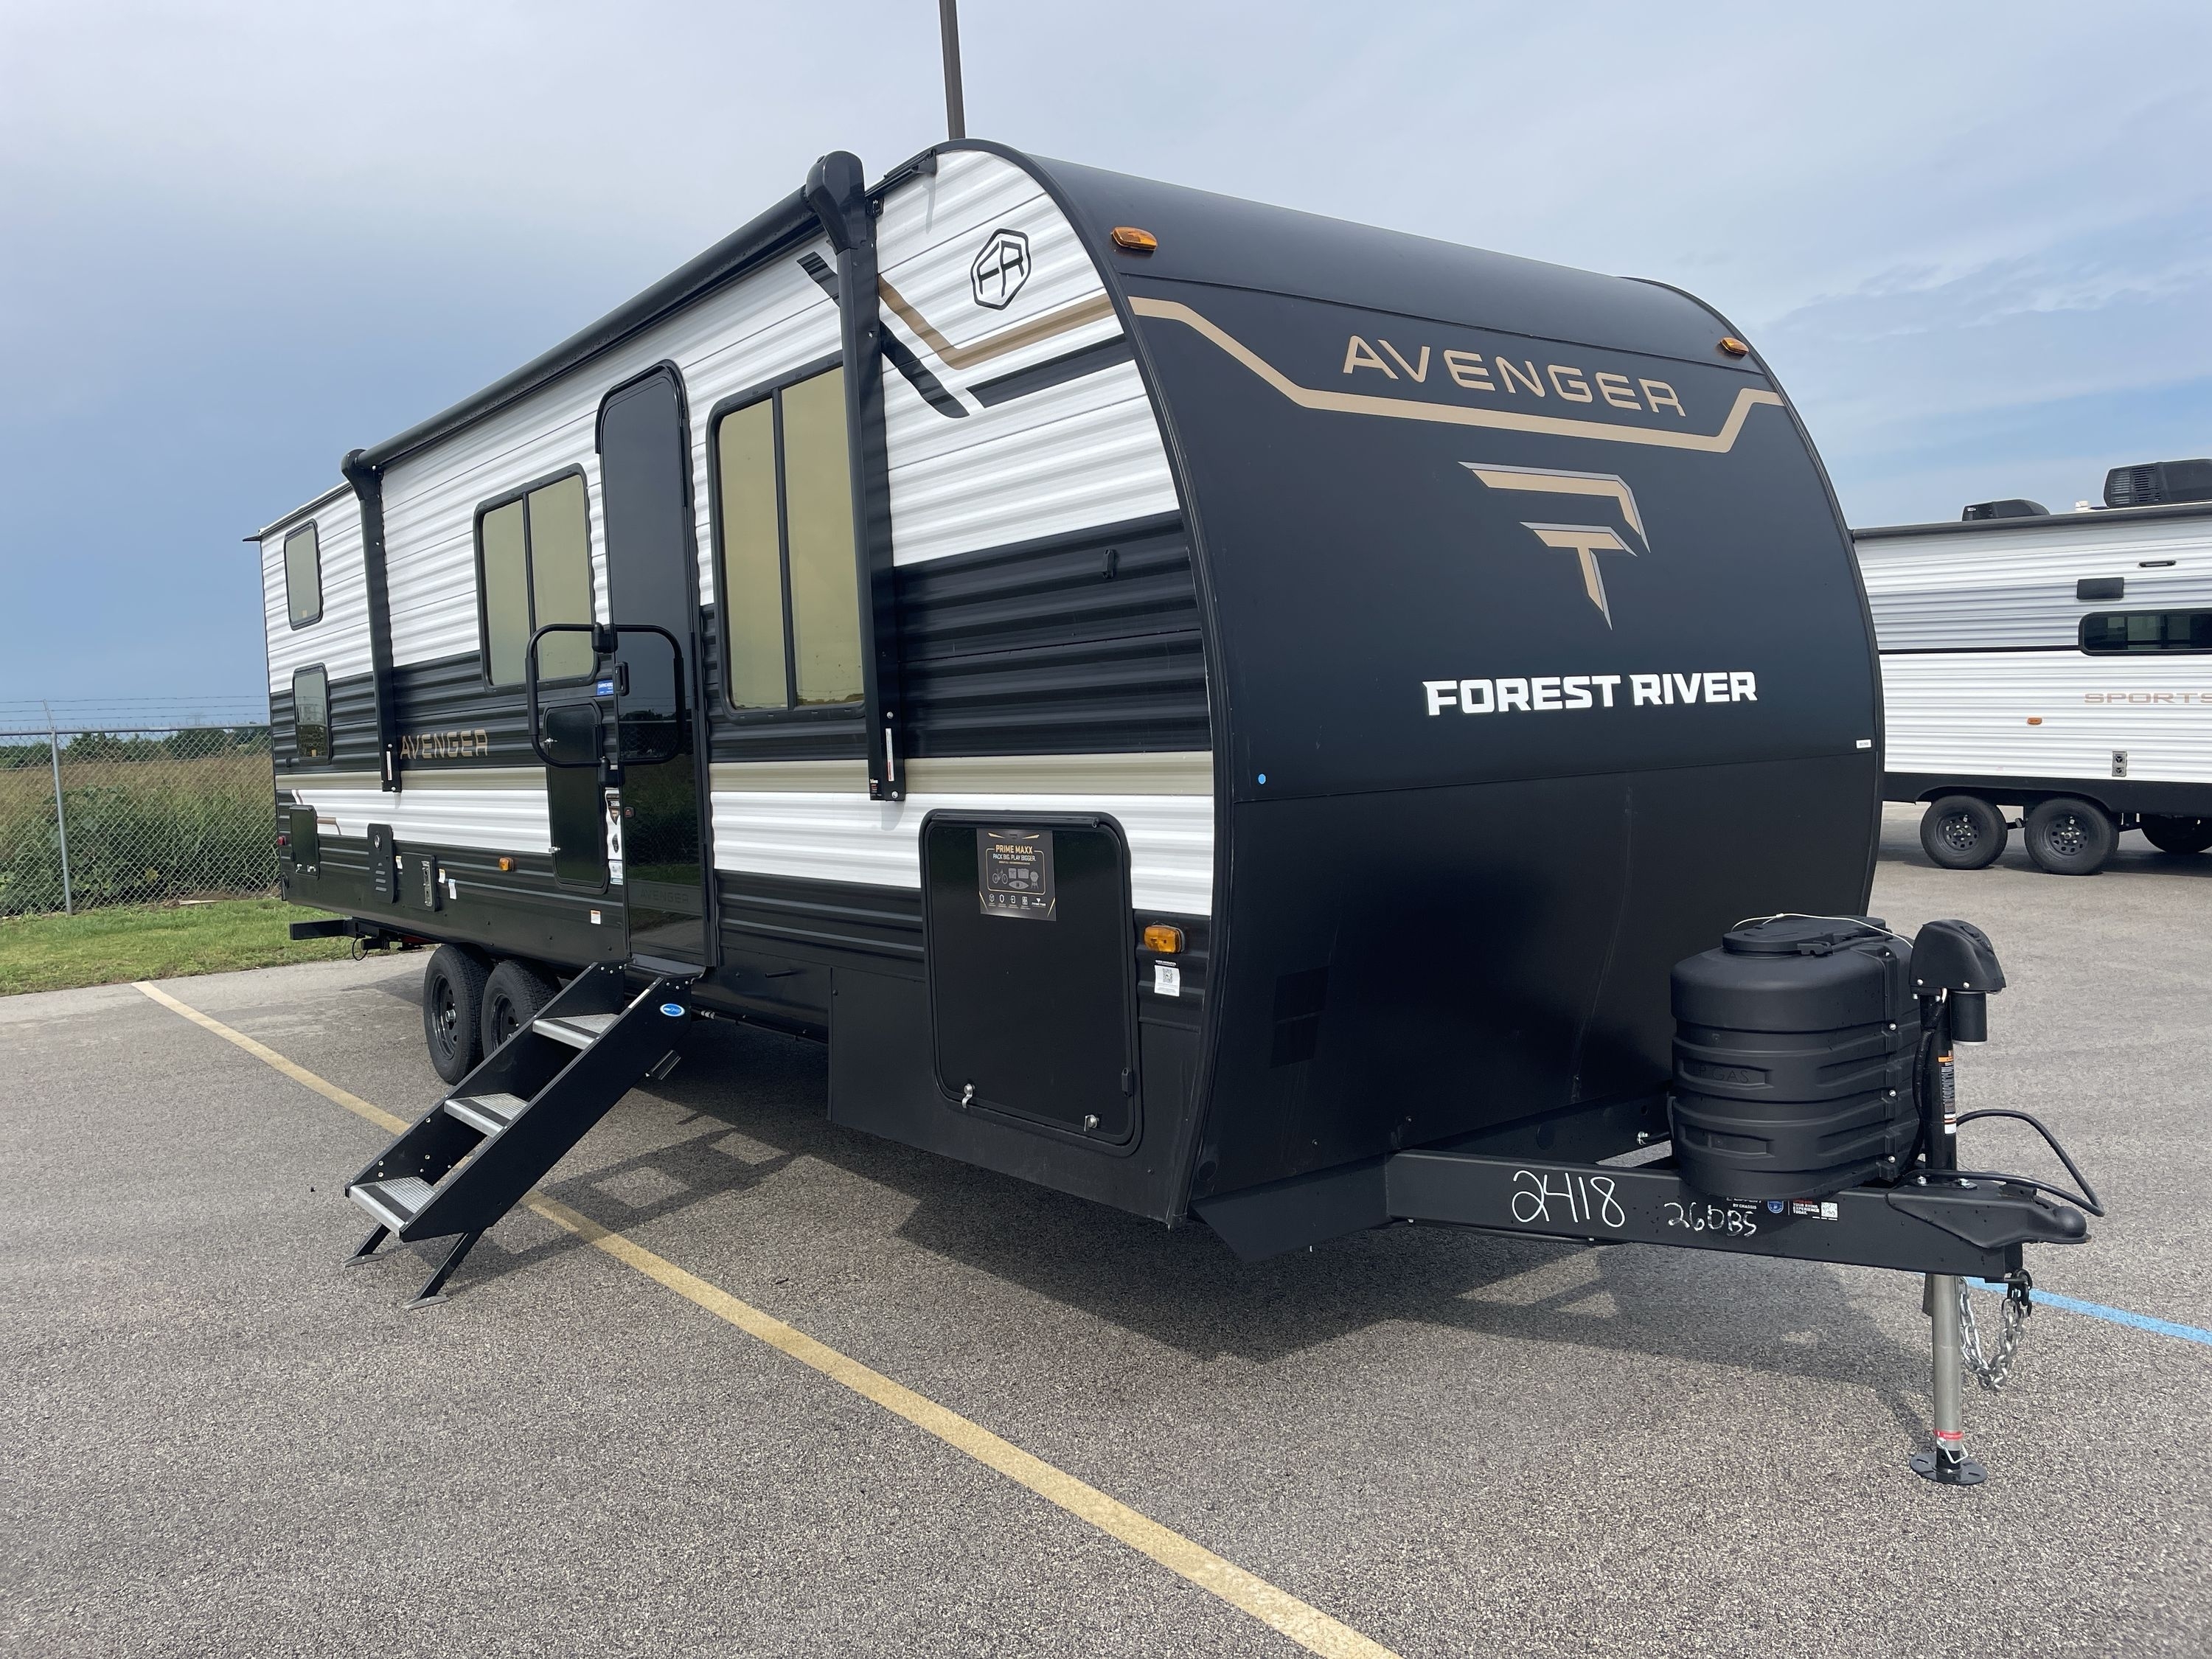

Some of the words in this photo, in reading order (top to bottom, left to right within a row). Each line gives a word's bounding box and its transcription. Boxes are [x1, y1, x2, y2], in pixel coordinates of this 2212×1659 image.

[1343, 335, 1686, 417] AVENGER
[1422, 675, 1622, 716] FOREST
[1629, 671, 1759, 706] RIVER
[400, 728, 488, 760] AVENGER
[995, 844, 1015, 853] PRIME
[1015, 845, 1033, 855] MAXX
[640, 886, 690, 904] AVENGER
[1711, 1066, 1750, 1084] GAS
[1512, 1169, 1625, 1228] 2418
